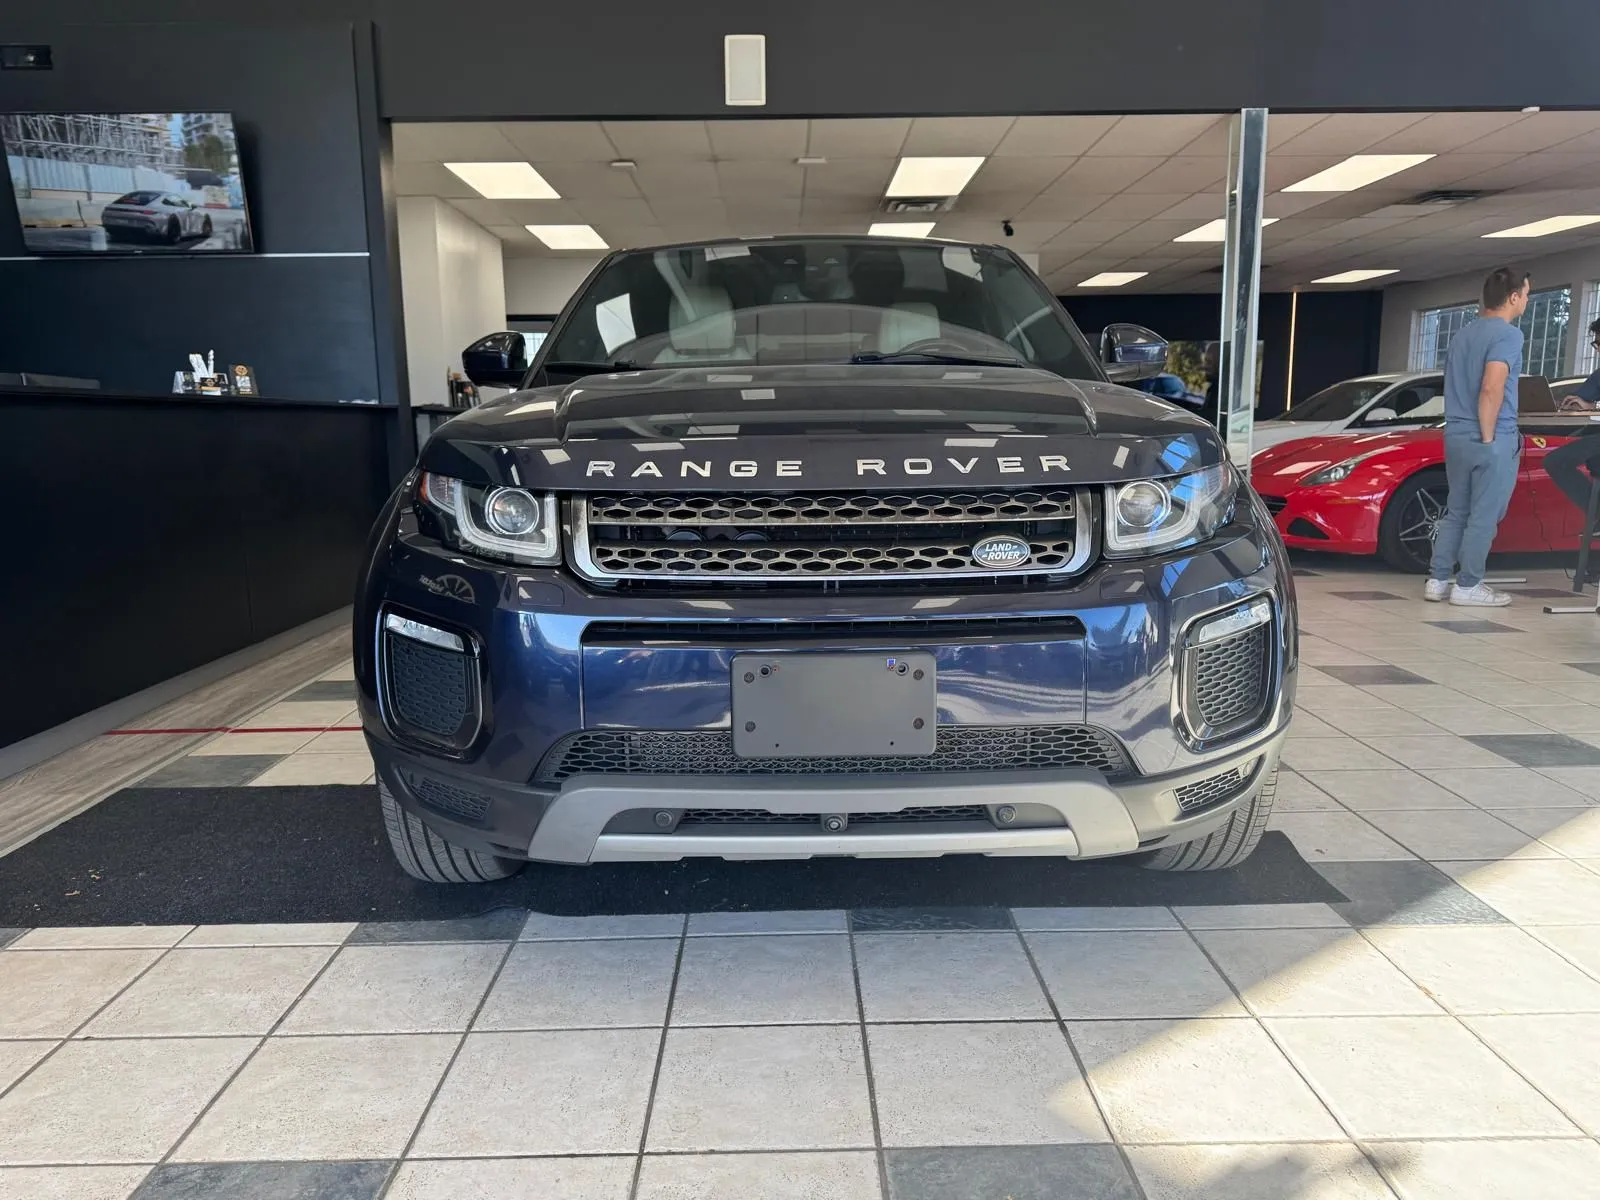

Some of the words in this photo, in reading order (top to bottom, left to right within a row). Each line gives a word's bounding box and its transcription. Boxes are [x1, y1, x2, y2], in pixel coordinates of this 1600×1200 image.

[585, 460, 803, 478] RANGE
[856, 455, 1072, 476] ROVER
[985, 543, 1012, 552] LAND
[987, 551, 1020, 561] ROVER
